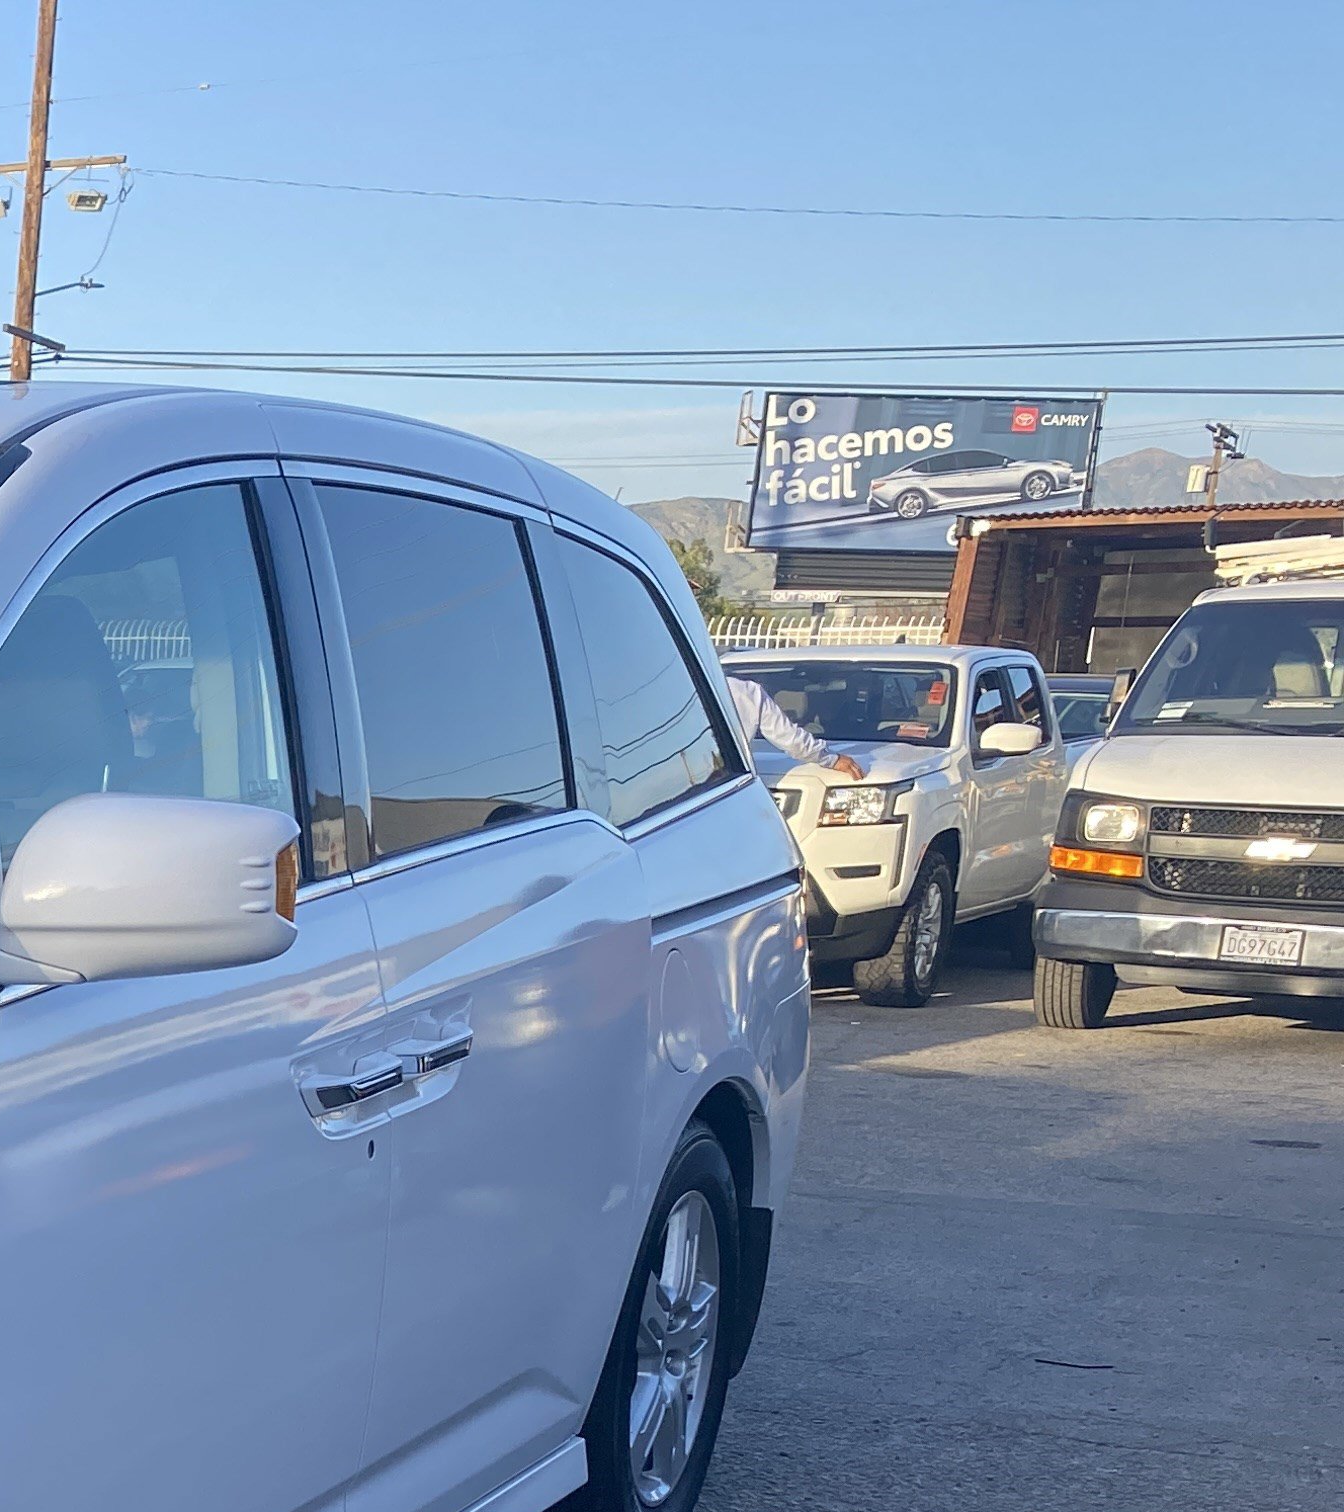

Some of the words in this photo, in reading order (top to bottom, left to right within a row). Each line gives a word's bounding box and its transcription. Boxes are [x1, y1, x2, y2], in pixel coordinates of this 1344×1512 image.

[767, 395, 817, 427] Lo
[1040, 414, 1090, 428] CAMRY
[765, 421, 954, 467] hacemos
[765, 461, 858, 507] fácil
[1227, 937, 1297, 957] DG97G47
